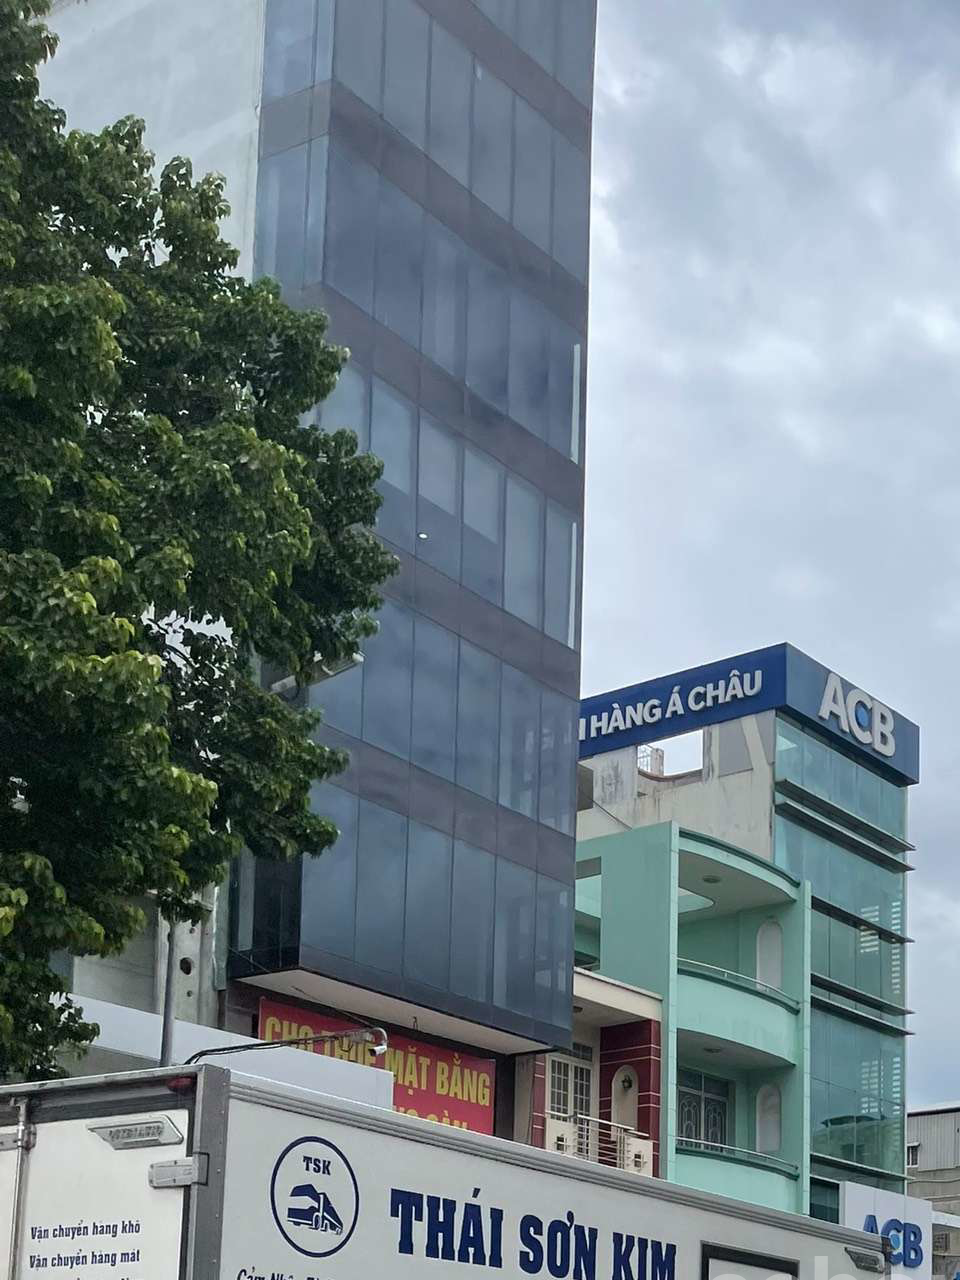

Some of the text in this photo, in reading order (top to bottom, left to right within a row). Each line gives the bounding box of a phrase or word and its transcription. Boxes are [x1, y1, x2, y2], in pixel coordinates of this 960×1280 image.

[591, 699, 662, 737] HÀNG
[665, 685, 685, 718] Á
[688, 669, 762, 711] CHÂU
[818, 672, 897, 757] ACB
[436, 1052, 490, 1106] BẰNG
[303, 1155, 331, 1176] TSK
[390, 1187, 504, 1269] THÁI
